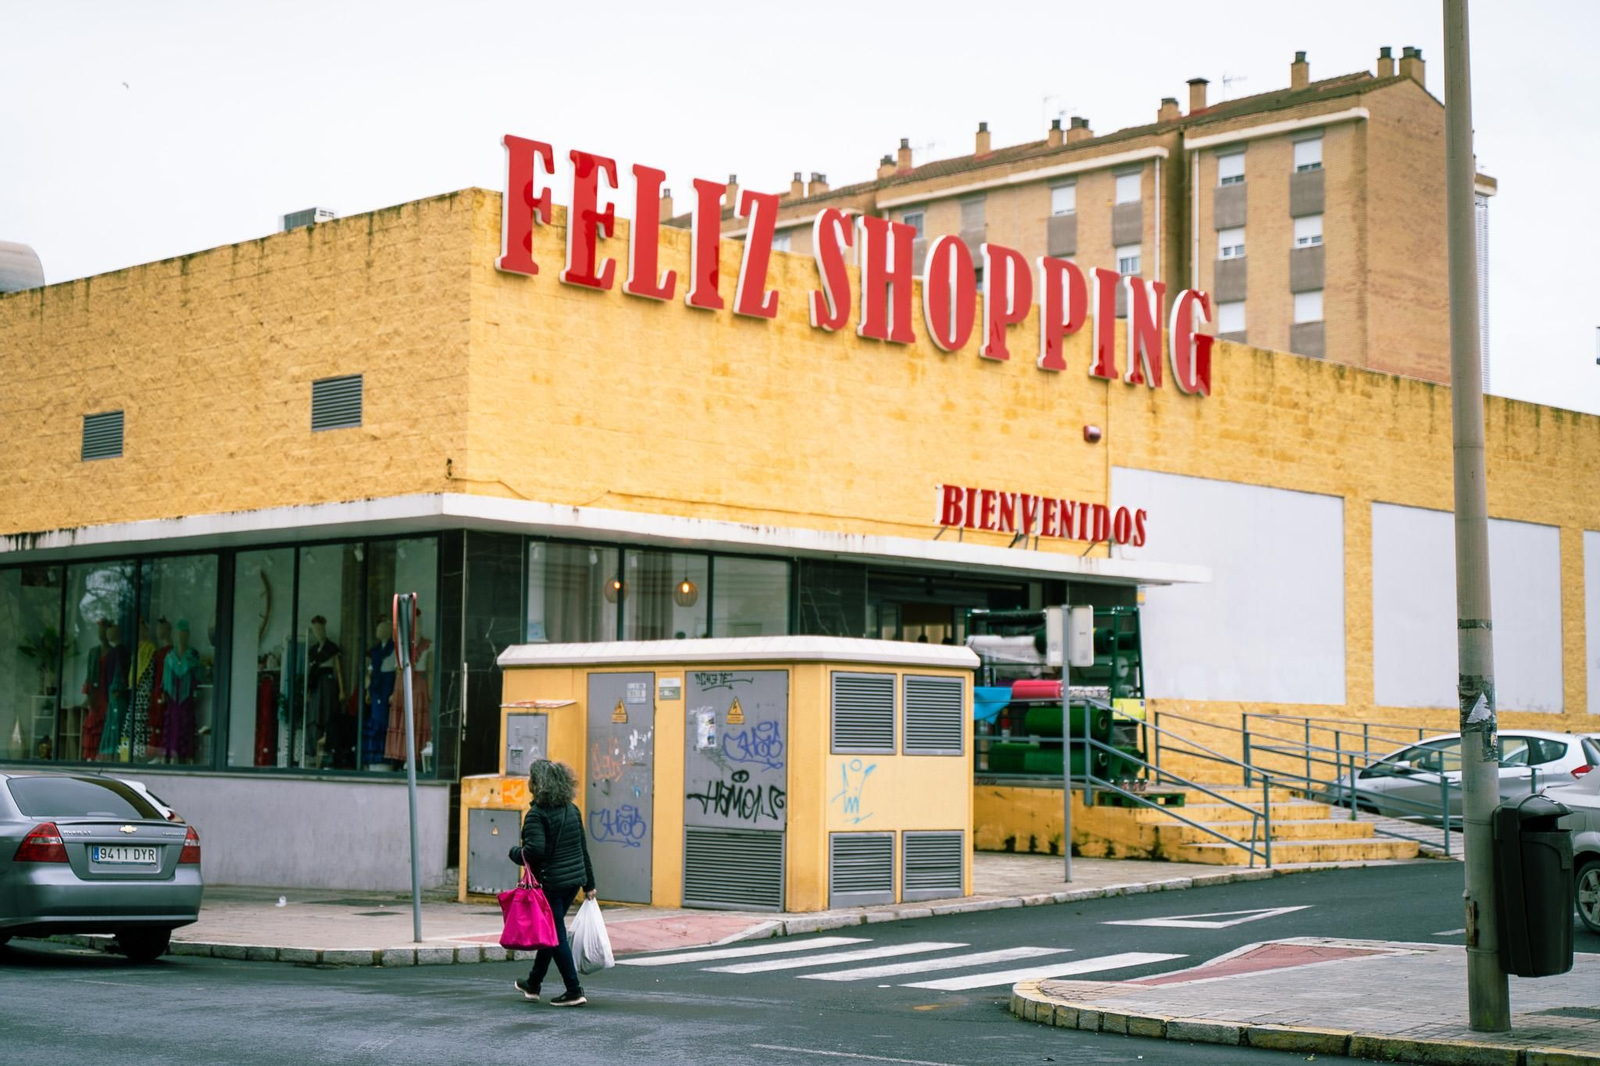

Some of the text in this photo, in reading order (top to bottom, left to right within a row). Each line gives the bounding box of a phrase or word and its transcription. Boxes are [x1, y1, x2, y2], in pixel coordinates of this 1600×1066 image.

[495, 134, 1215, 397] FELIZ SHOPPING
[936, 484, 1148, 548] BIENVENIDOS
[100, 847, 155, 861] 9411 DYR
